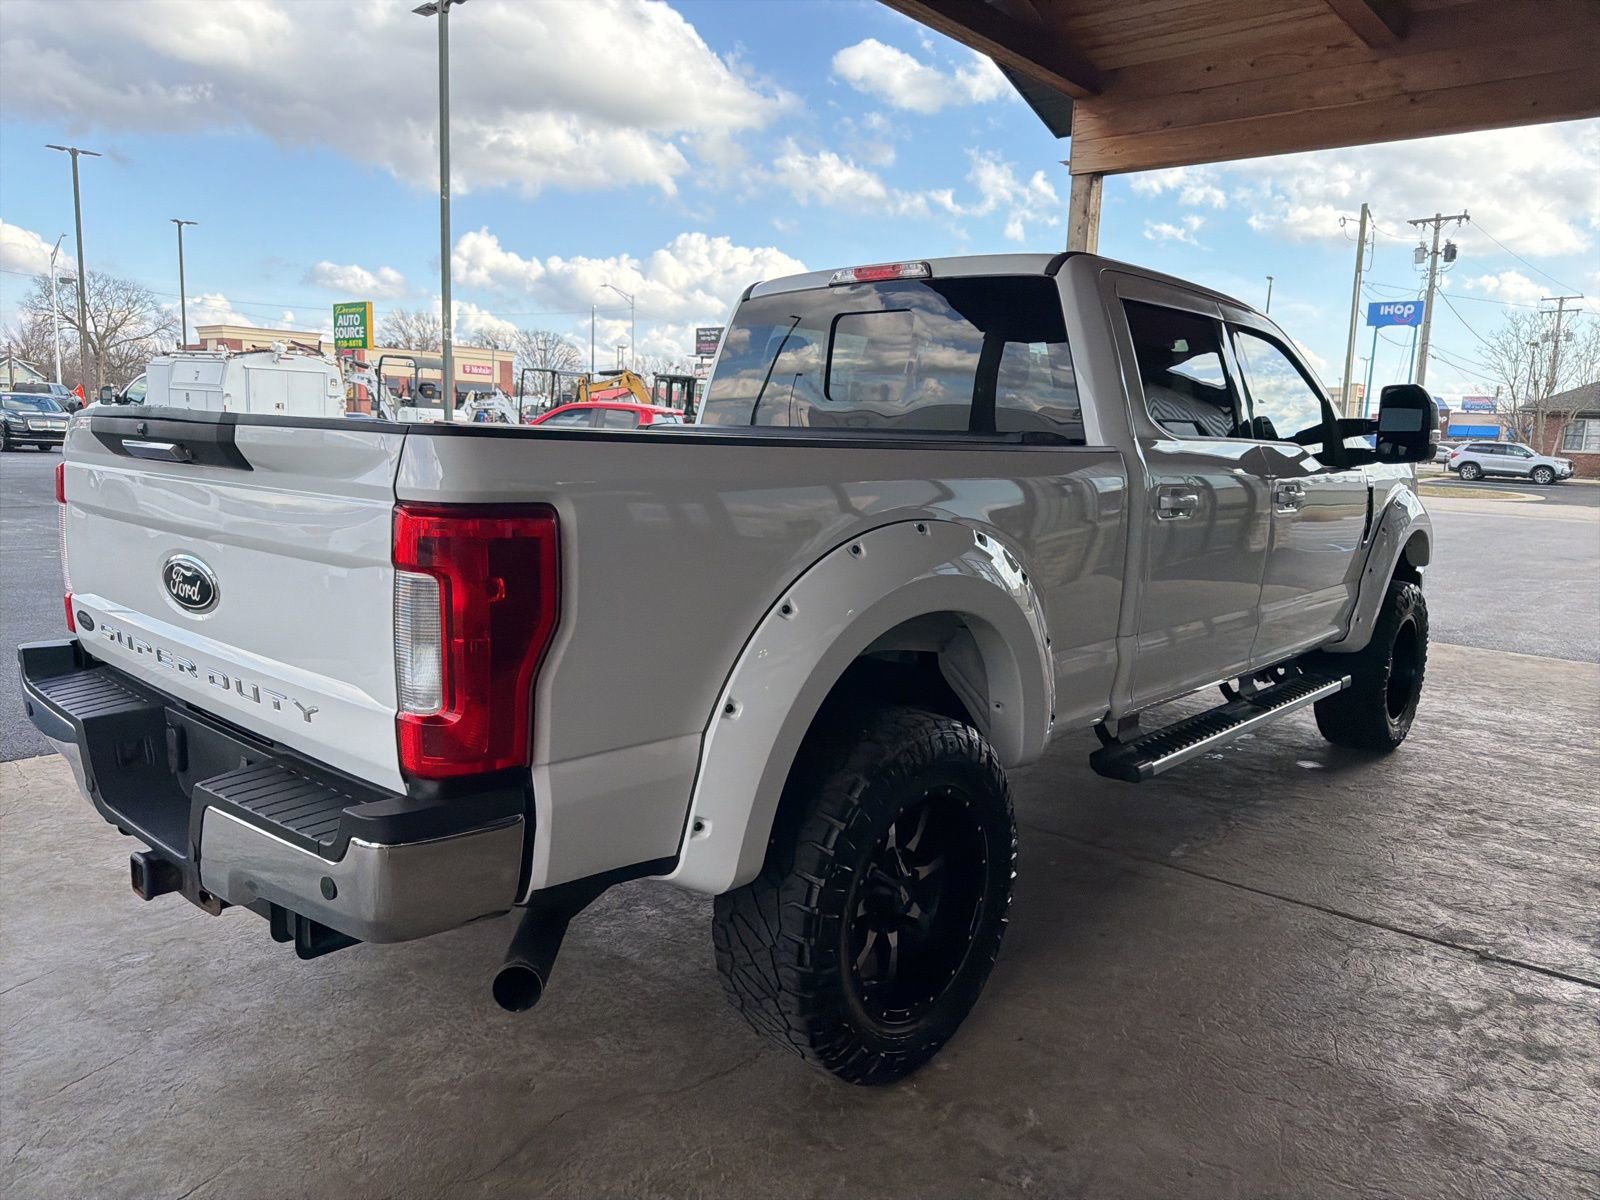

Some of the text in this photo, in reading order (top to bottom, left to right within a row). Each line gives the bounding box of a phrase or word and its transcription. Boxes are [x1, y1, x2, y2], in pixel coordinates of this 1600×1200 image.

[1380, 304, 1415, 318] IHOP
[337, 314, 360, 326] AUTO
[335, 326, 365, 338] SOURCE
[171, 566, 201, 602] Ford
[100, 623, 320, 724] SUPER DUTY
